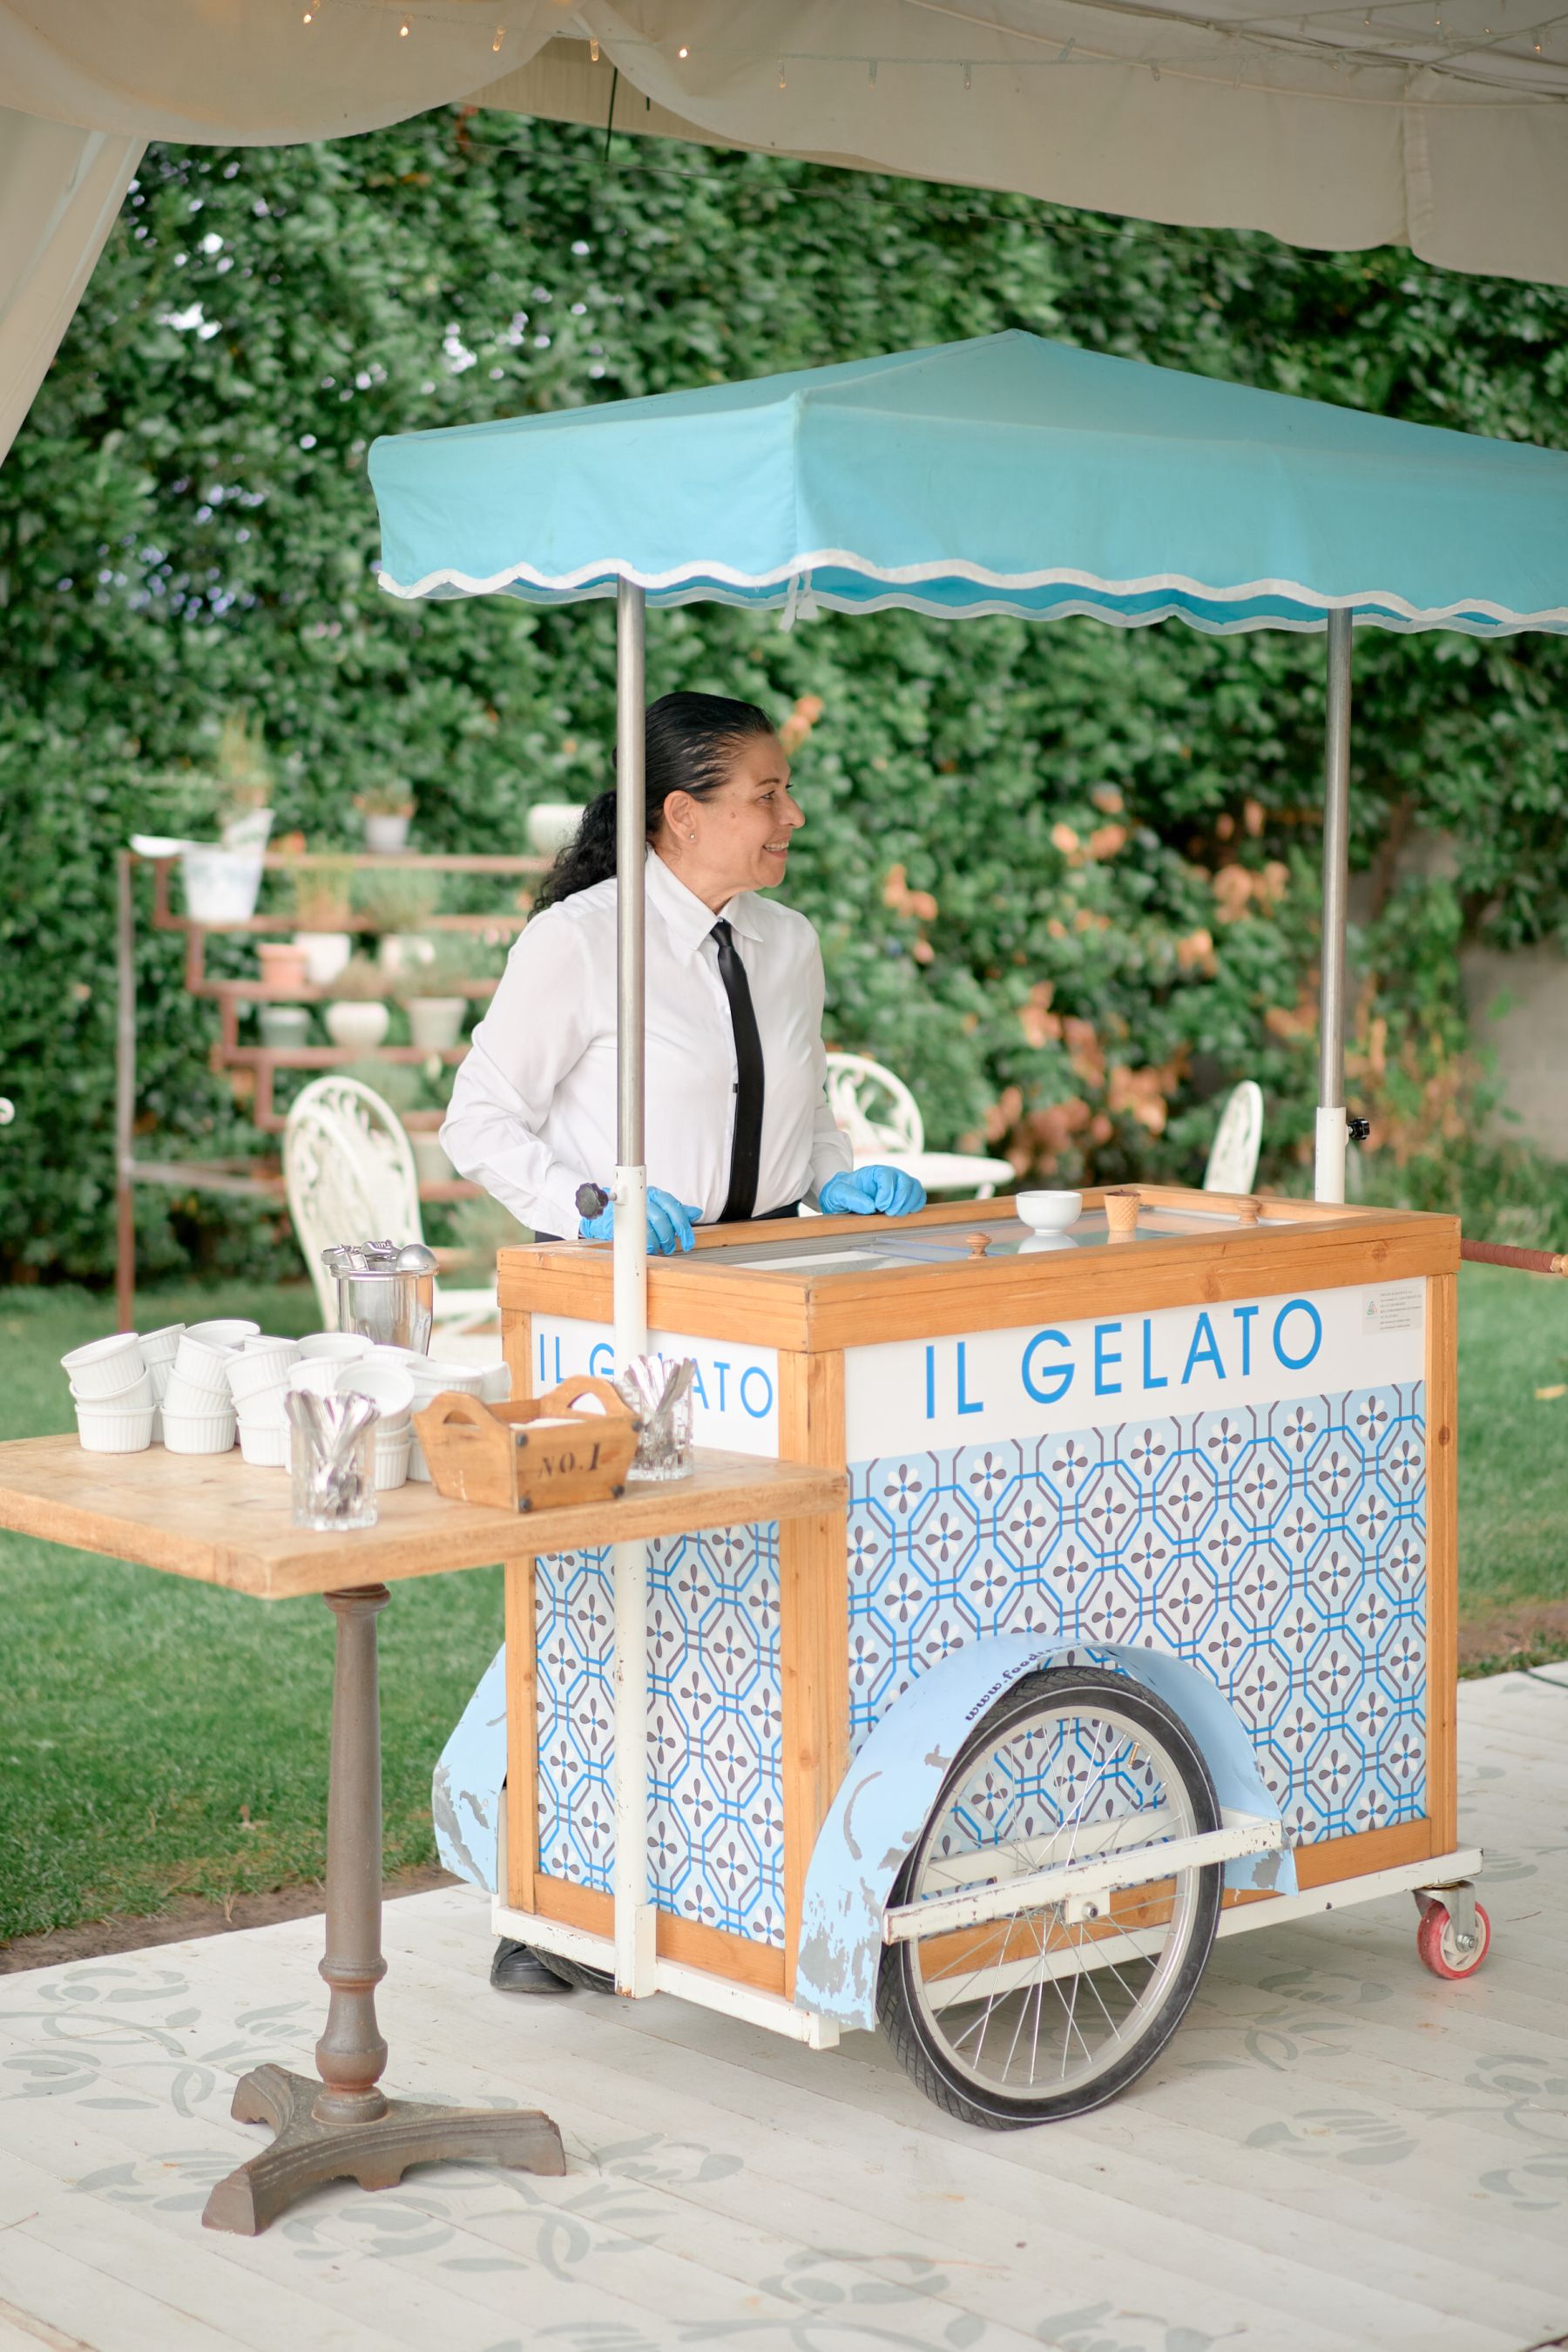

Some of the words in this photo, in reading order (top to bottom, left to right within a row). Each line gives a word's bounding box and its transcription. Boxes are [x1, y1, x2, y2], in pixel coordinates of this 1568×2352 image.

[539, 1334, 564, 1383] IL
[589, 1342, 774, 1418] GATO
[926, 1342, 983, 1420] IL
[1021, 1299, 1322, 1405] GELATO
